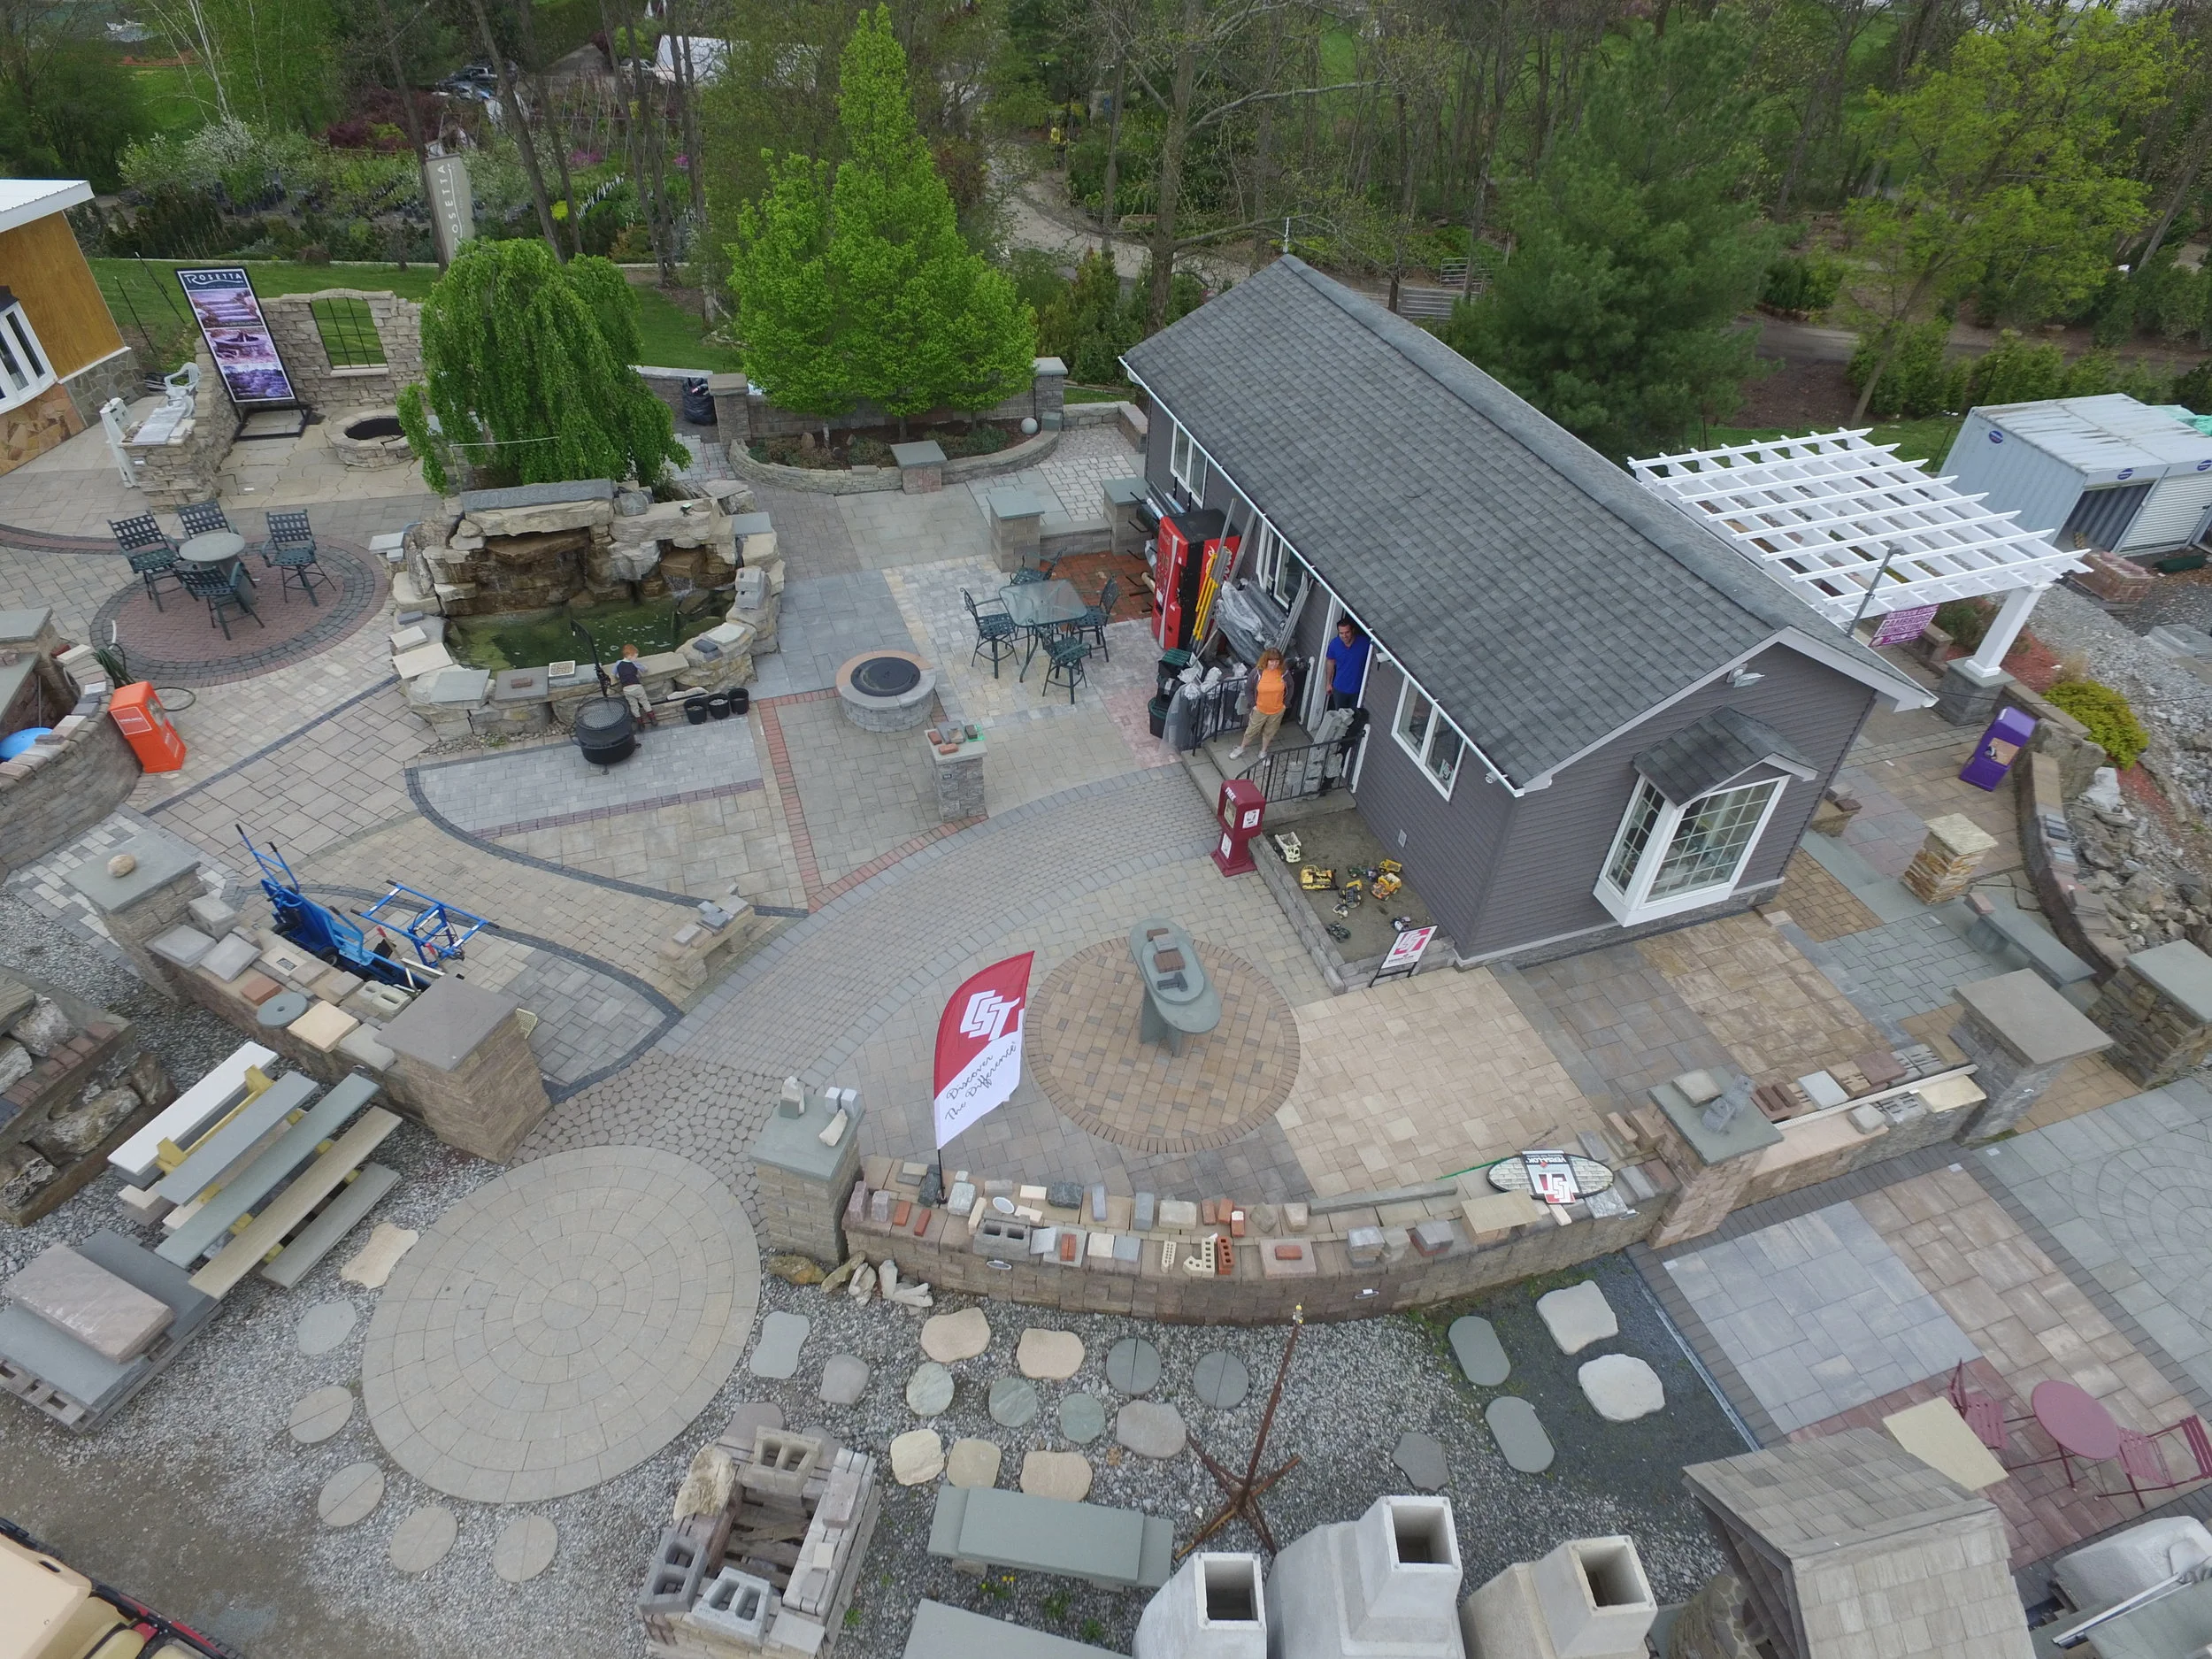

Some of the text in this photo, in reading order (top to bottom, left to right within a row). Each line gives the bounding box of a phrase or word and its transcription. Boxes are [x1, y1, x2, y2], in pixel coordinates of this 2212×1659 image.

[184, 273, 244, 285] ROSETTA
[1881, 612, 1934, 628] CAMBRIDGE
[960, 989, 1020, 1041] CST
[946, 1055, 994, 1101] Discover
[944, 1101, 967, 1121] The
